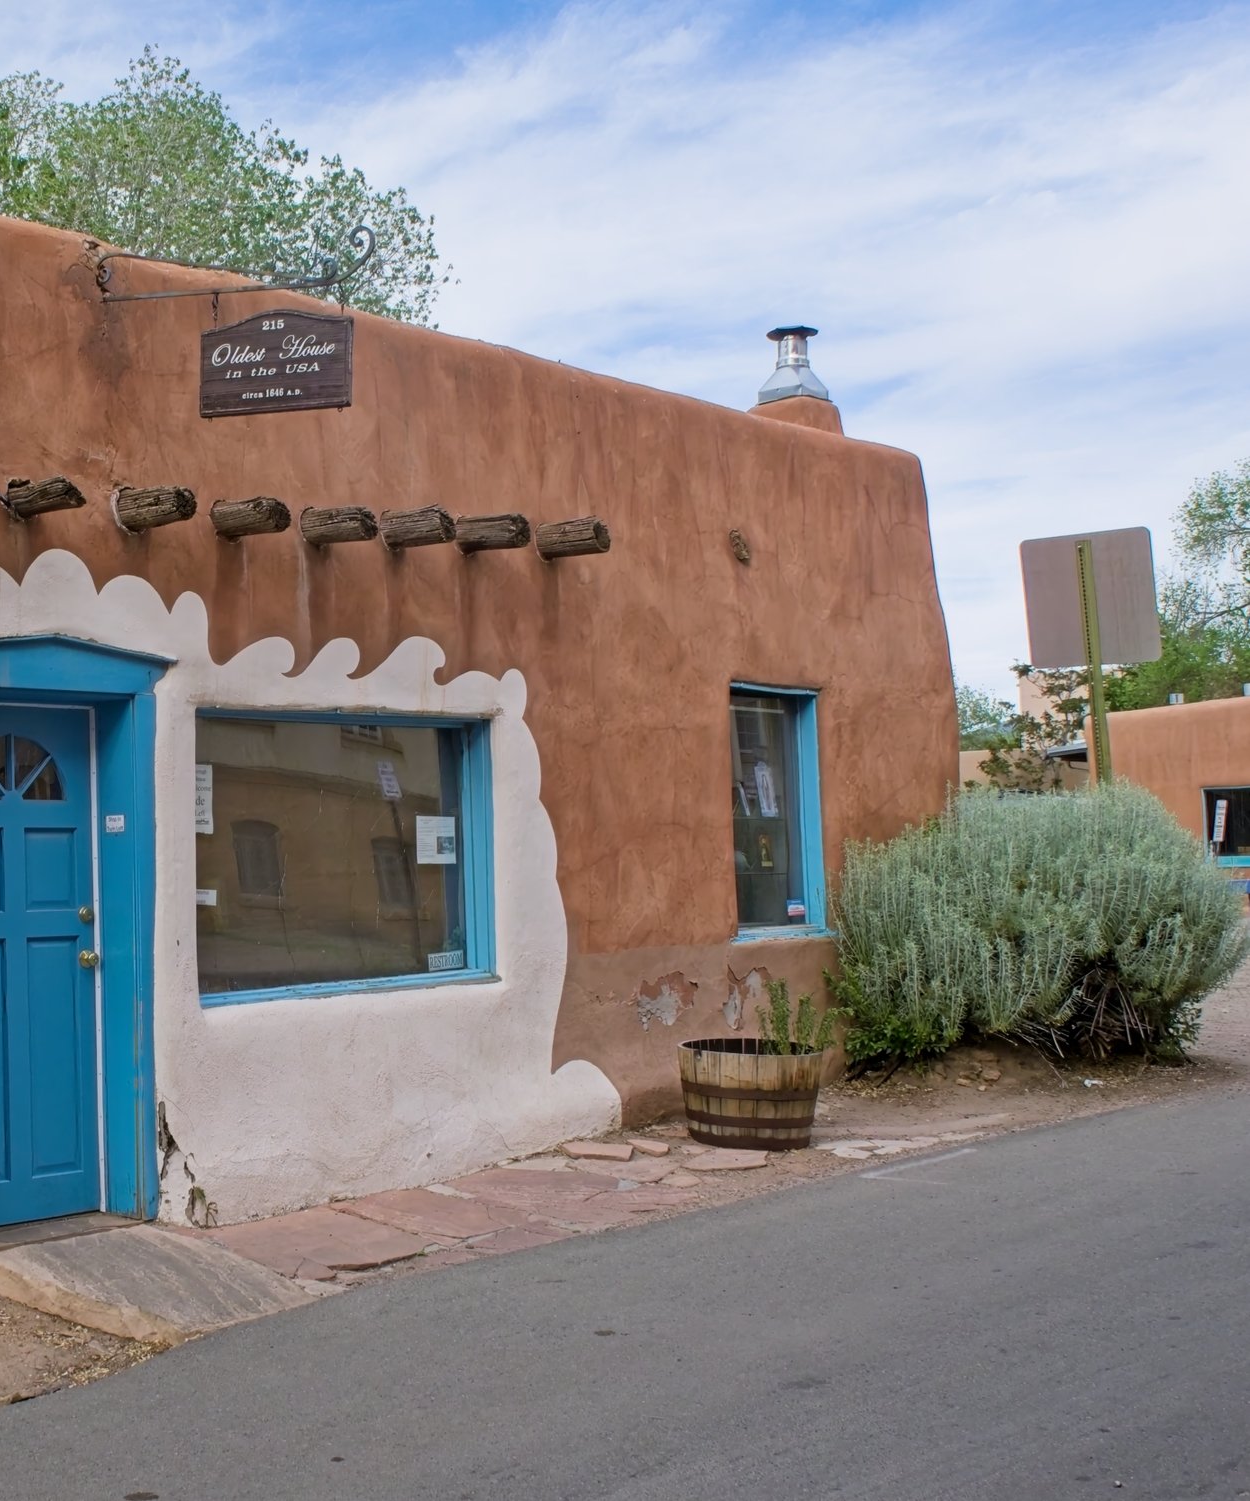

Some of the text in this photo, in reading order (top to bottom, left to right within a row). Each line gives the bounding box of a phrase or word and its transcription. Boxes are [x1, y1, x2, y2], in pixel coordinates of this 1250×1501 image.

[262, 319, 285, 331] 215
[211, 334, 336, 367] Oldest House
[224, 361, 320, 379] in the USA
[242, 390, 264, 400] circa
[265, 387, 284, 398] 1646
[429, 952, 463, 969] RESTROOM
